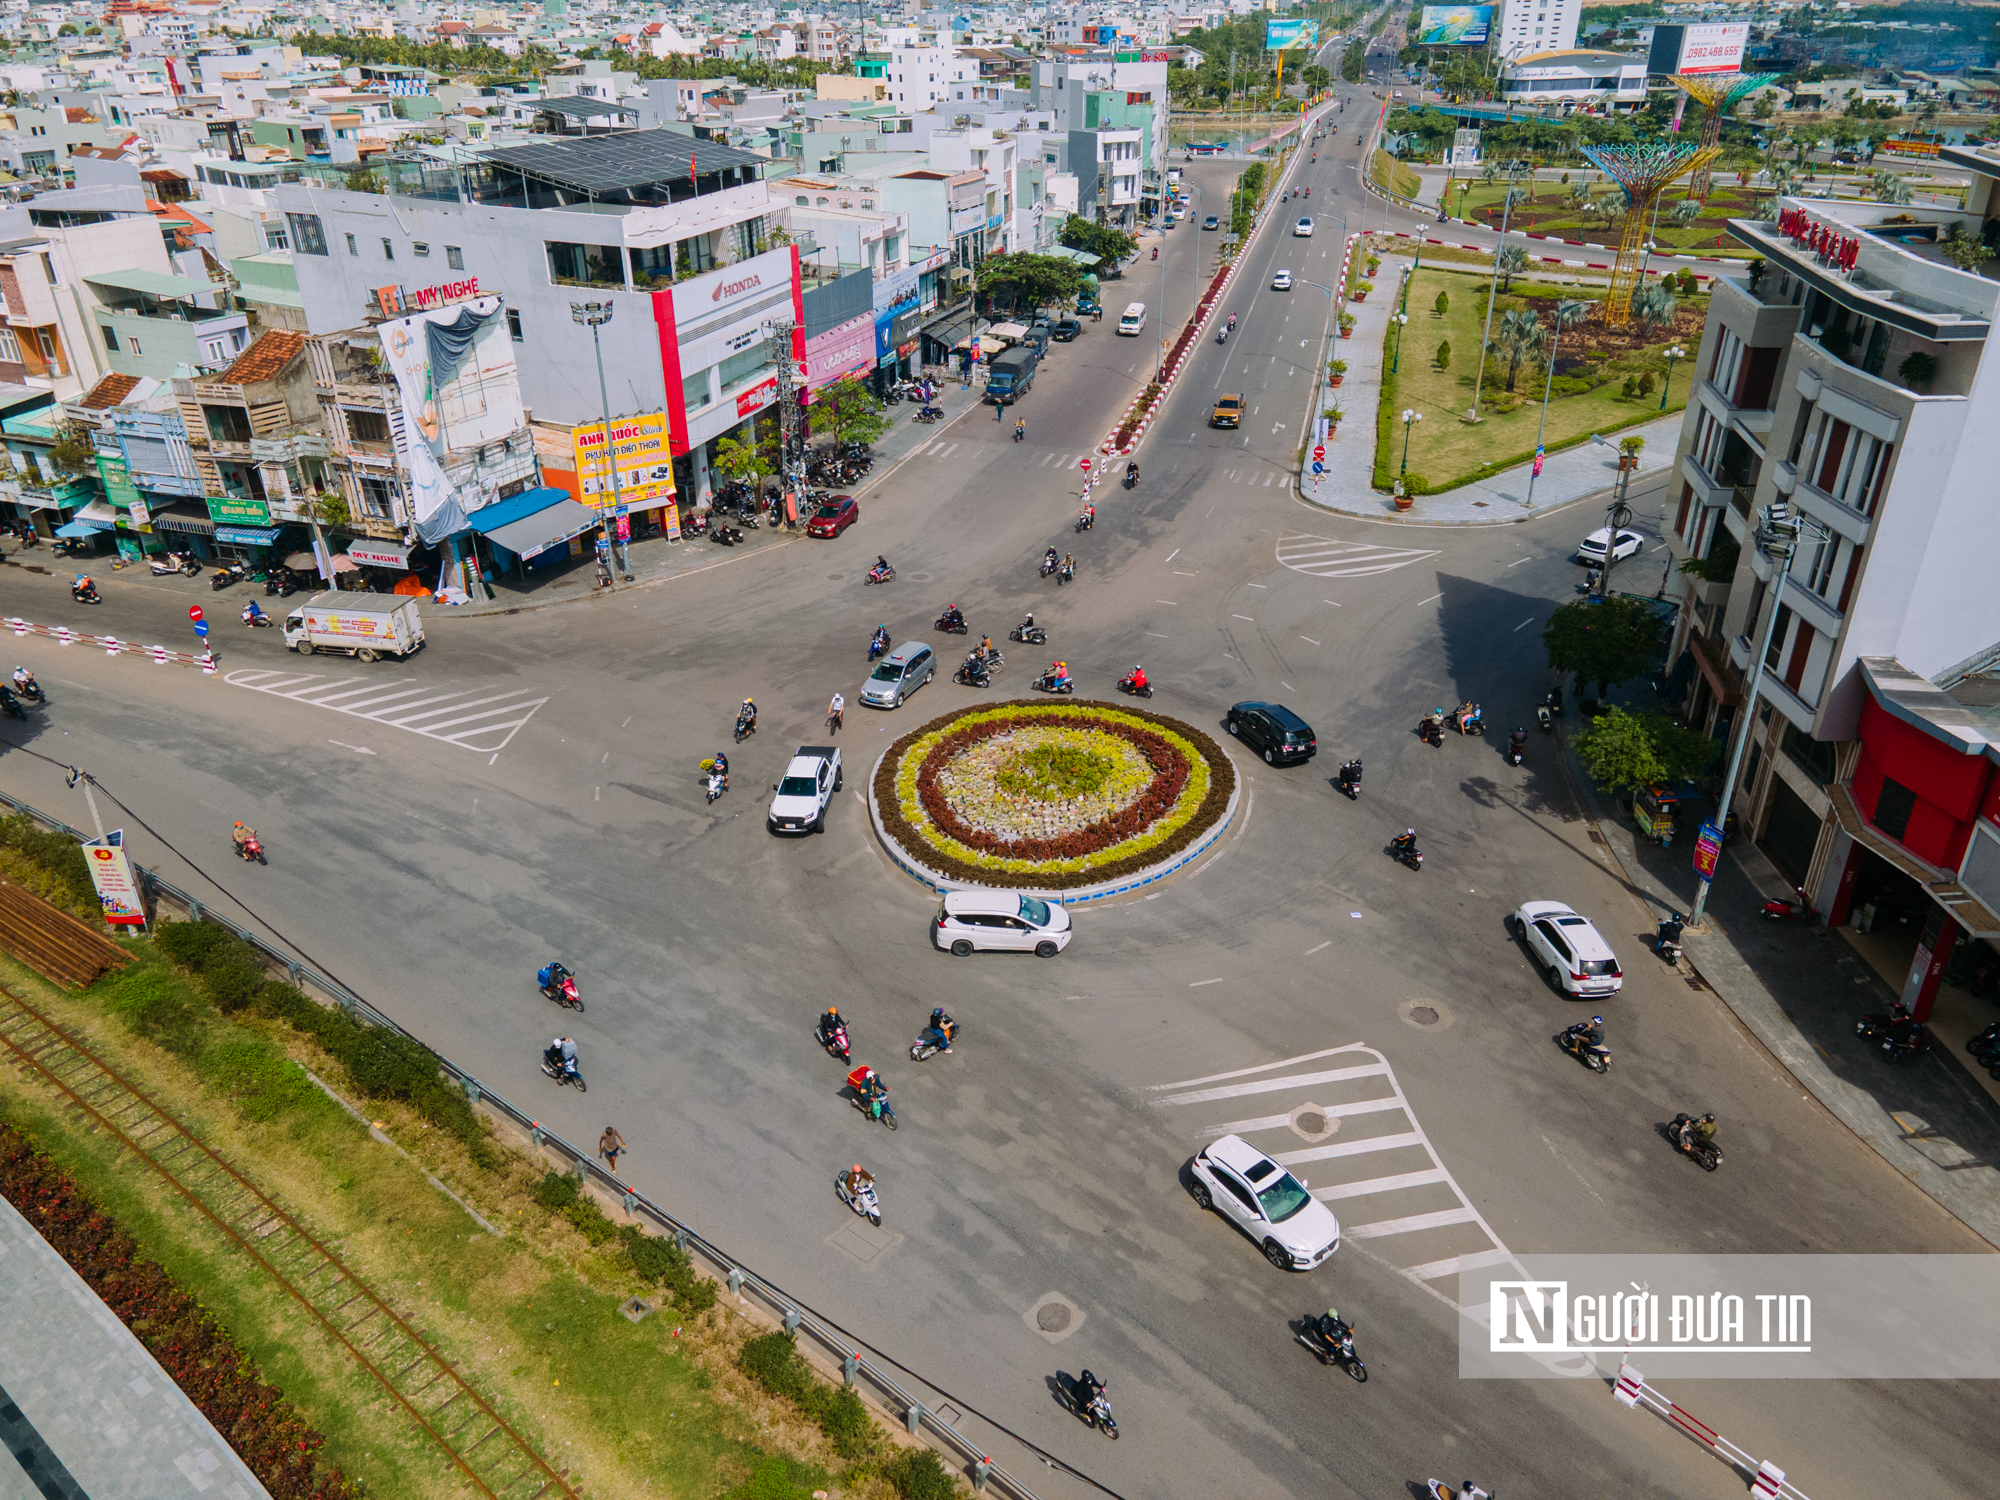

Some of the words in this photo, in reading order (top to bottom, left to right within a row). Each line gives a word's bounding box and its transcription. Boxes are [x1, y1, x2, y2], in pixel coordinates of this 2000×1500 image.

[442, 275, 480, 299] NGHỆ
[723, 274, 761, 298] HONDA
[579, 432, 604, 446] ANH
